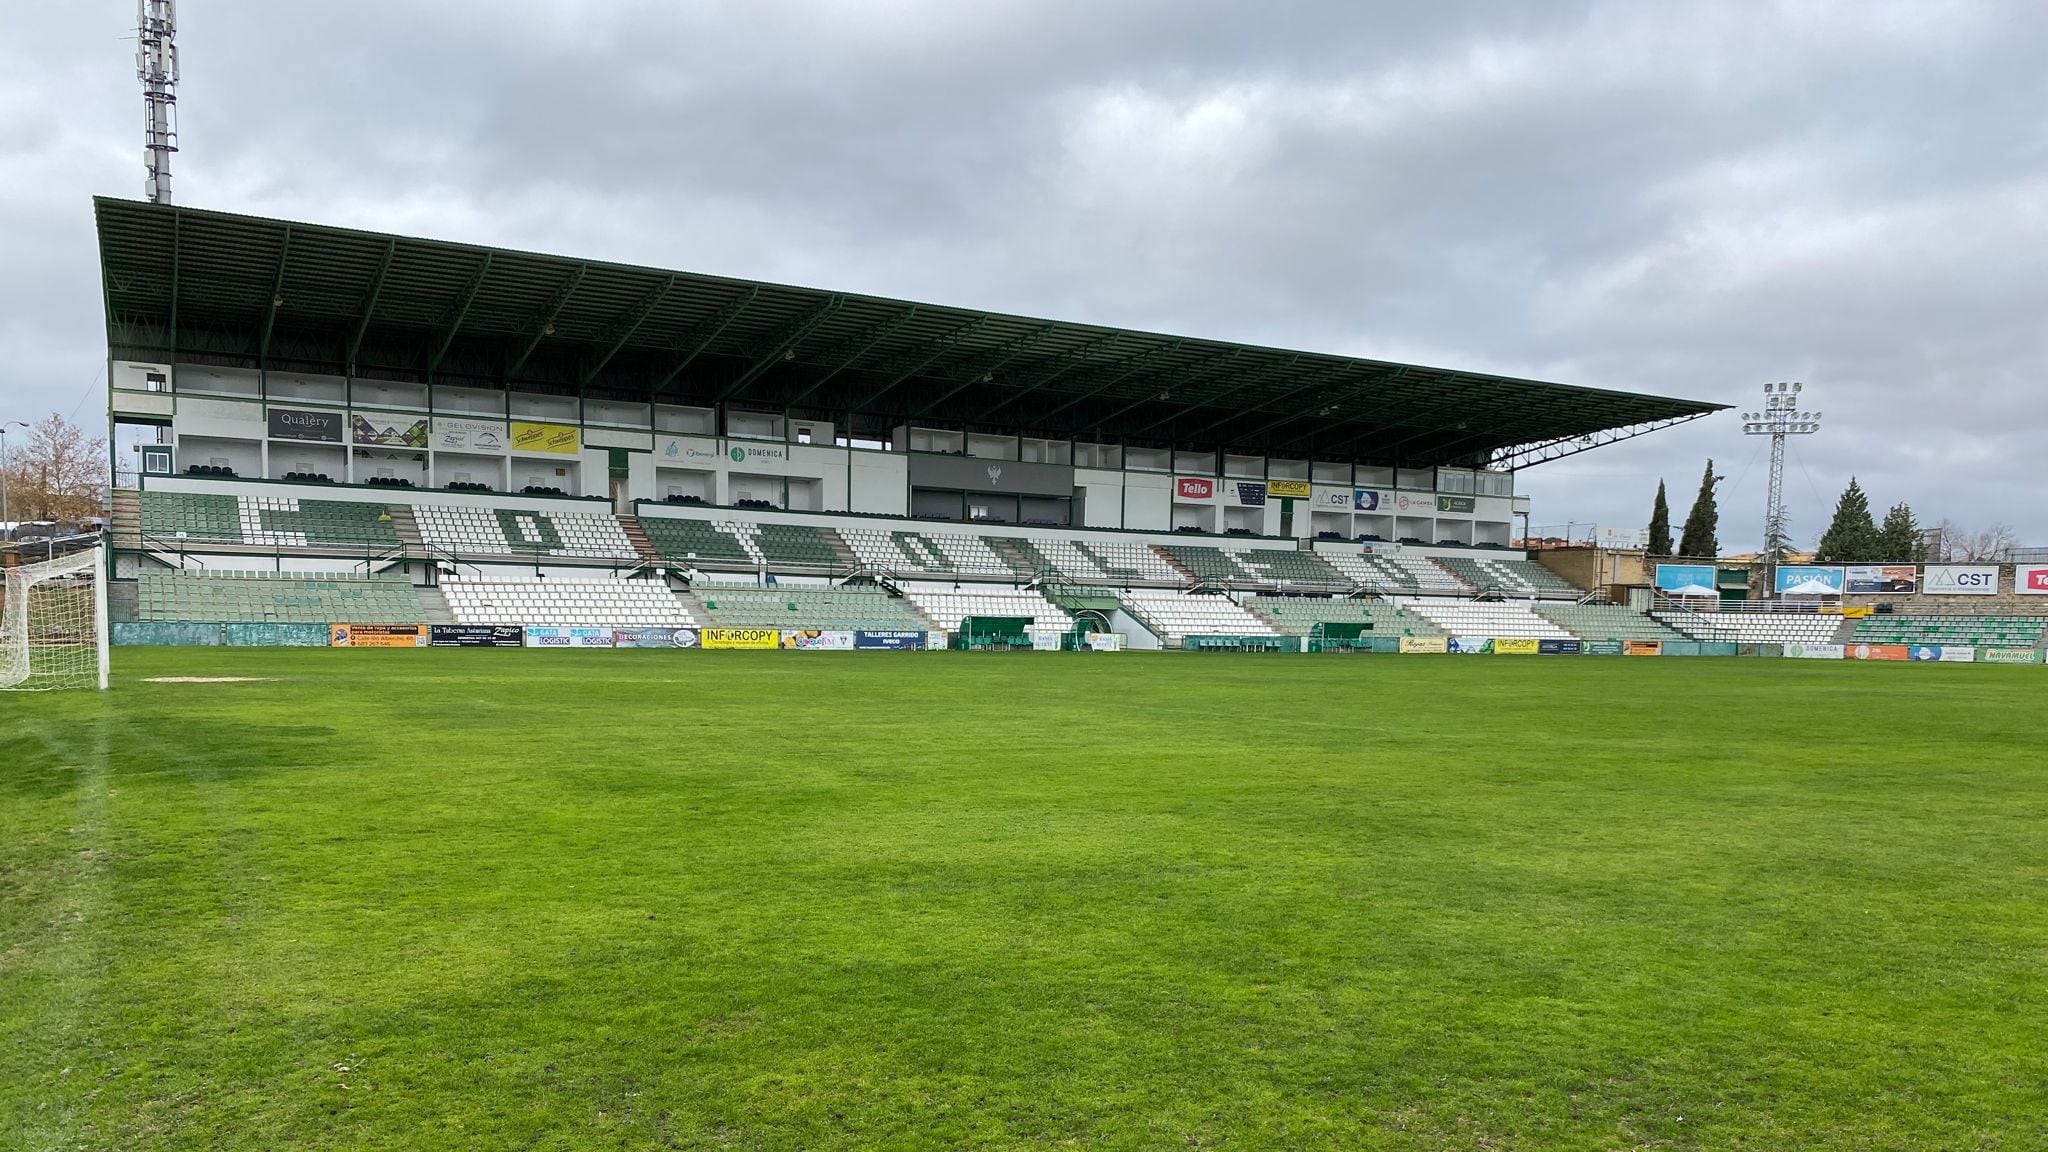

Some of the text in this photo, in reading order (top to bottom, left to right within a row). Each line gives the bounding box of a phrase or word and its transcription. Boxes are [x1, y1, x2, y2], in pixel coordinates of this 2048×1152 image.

[447, 422, 503, 432] GELOVISION
[748, 448, 782, 458] DOMENICA
[1183, 482, 1208, 494] Tello
[1331, 495, 1349, 505] CST
[1786, 573, 1832, 585] PASIÓN
[1958, 574, 1992, 586] CST
[493, 627, 520, 637] Zapico
[707, 630, 772, 640] INFORCOPY
[1989, 651, 2034, 660] NAVAMUEL
